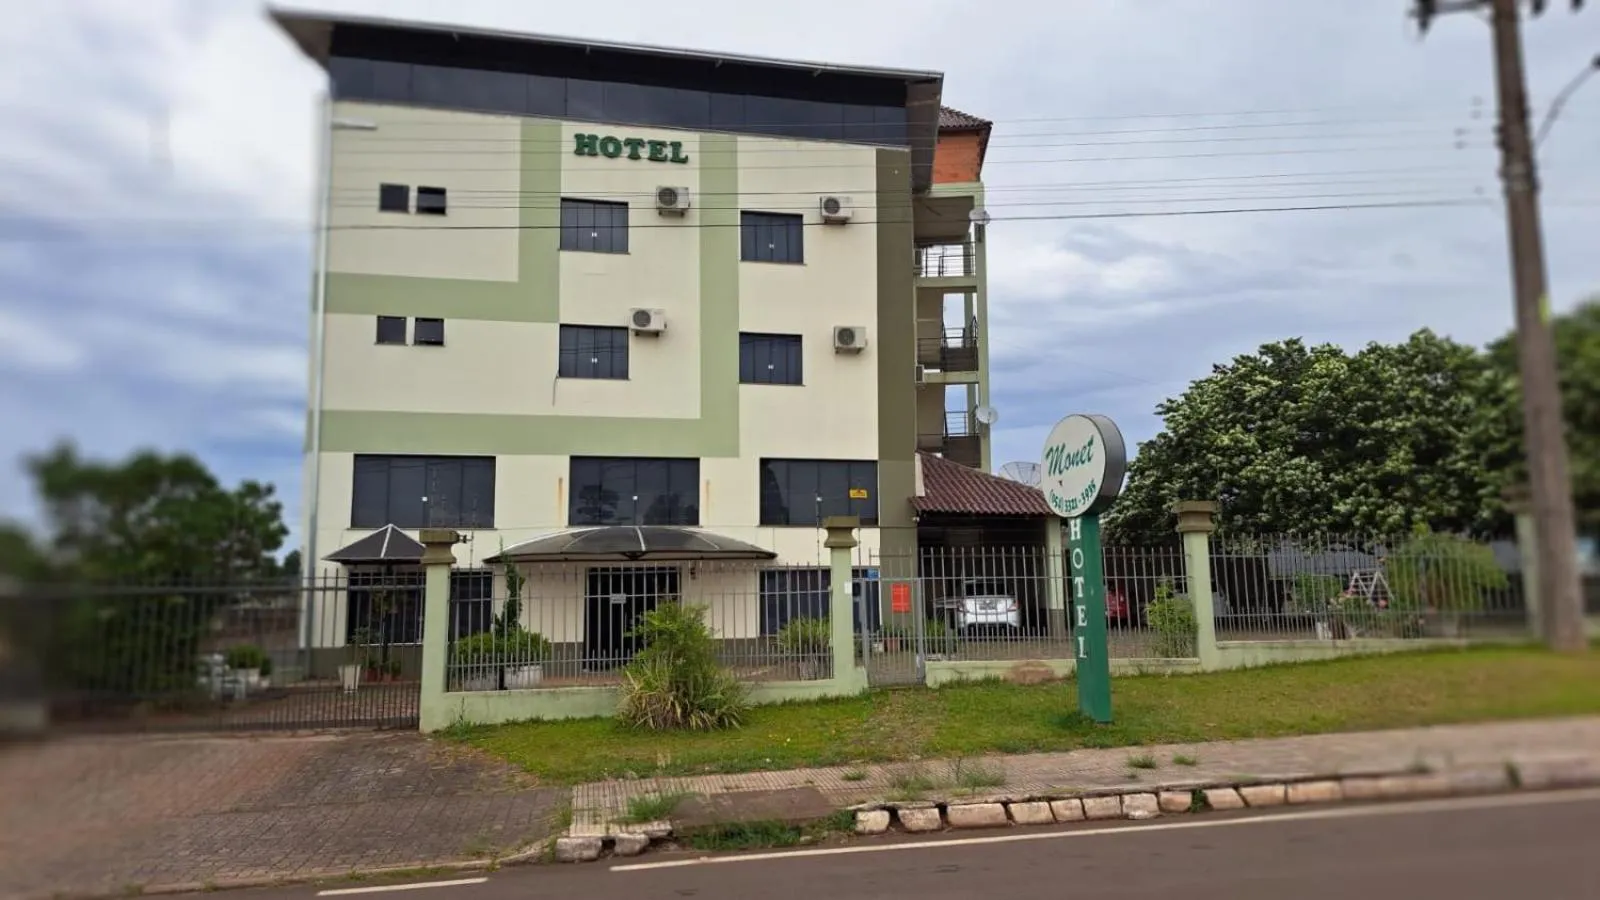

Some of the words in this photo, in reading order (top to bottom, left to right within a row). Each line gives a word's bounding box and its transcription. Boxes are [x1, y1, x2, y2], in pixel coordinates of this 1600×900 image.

[574, 133, 689, 164] HOTEL
[1045, 434, 1094, 477] Monet
[1069, 518, 1087, 659] HOTEL
